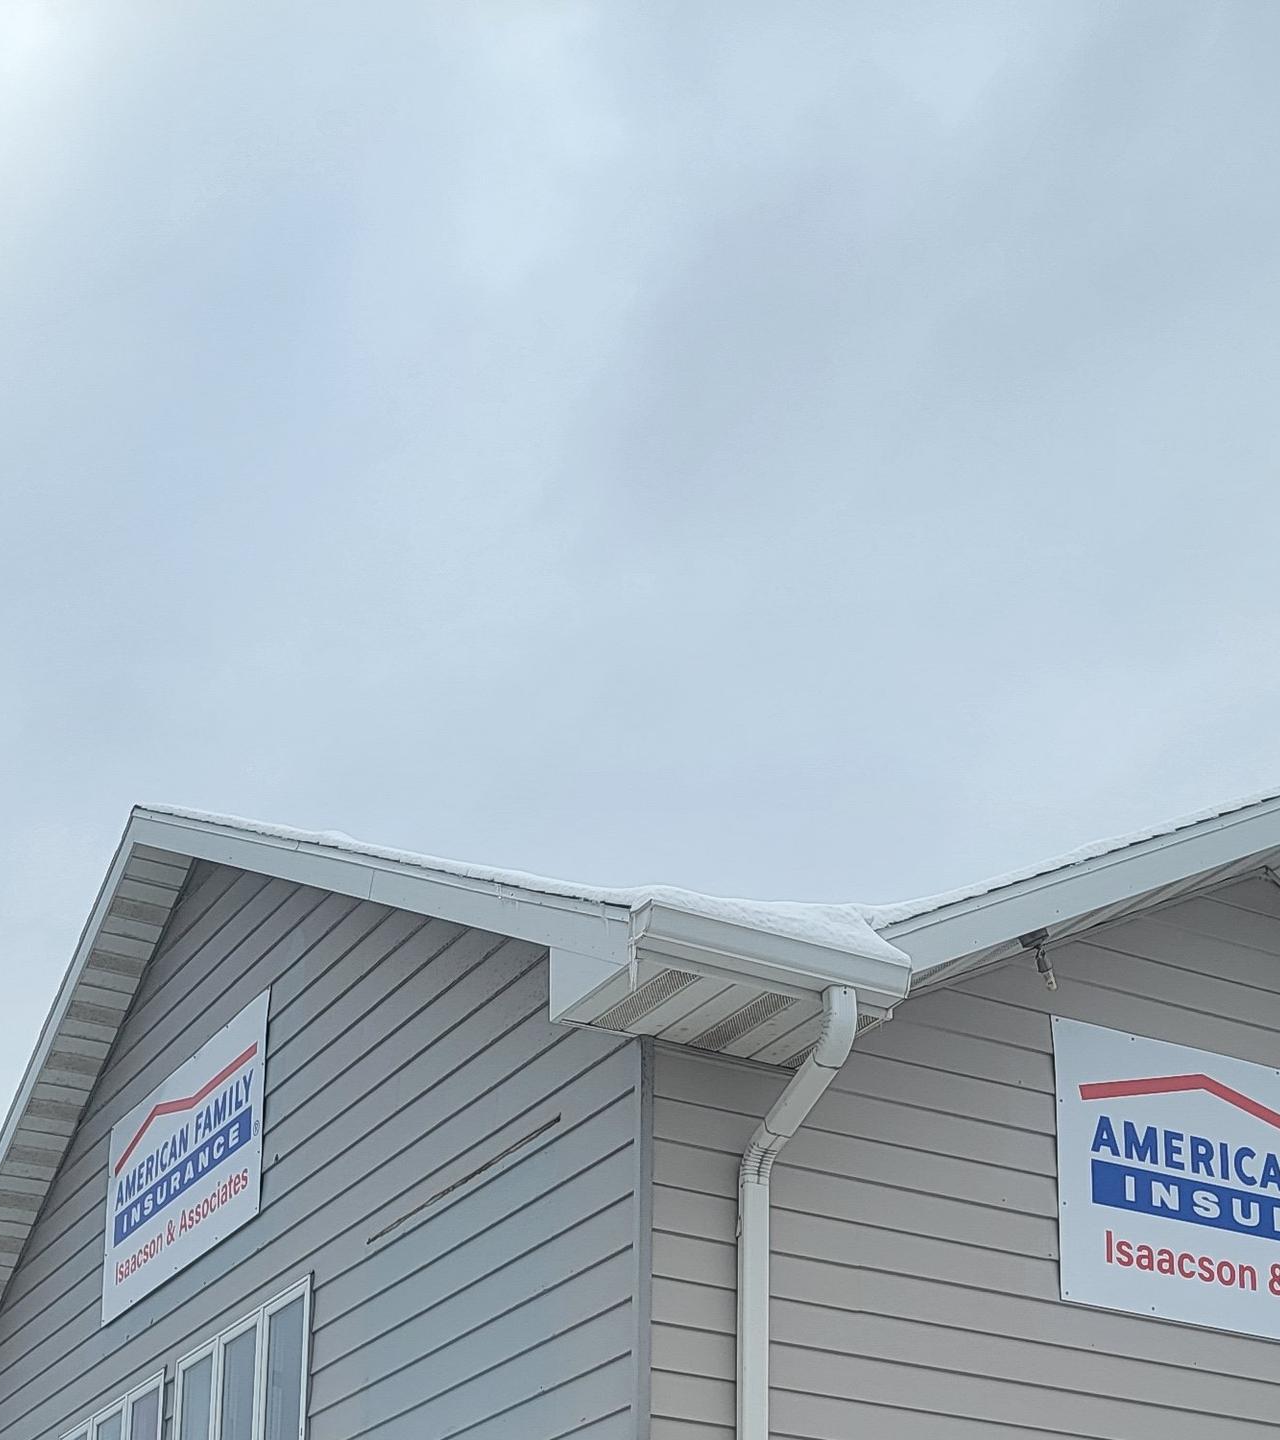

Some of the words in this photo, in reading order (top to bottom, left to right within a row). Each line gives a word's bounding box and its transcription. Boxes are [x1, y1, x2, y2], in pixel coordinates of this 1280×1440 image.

[115, 1126, 189, 1211] AMERICAN
[194, 1068, 255, 1142] FAMILY
[122, 1122, 240, 1233] INSURANCE
[115, 1236, 163, 1285] Isaacson
[166, 1220, 175, 1245] &
[179, 1167, 249, 1237] Associates
[1105, 1230, 1257, 1292] Isaacson
